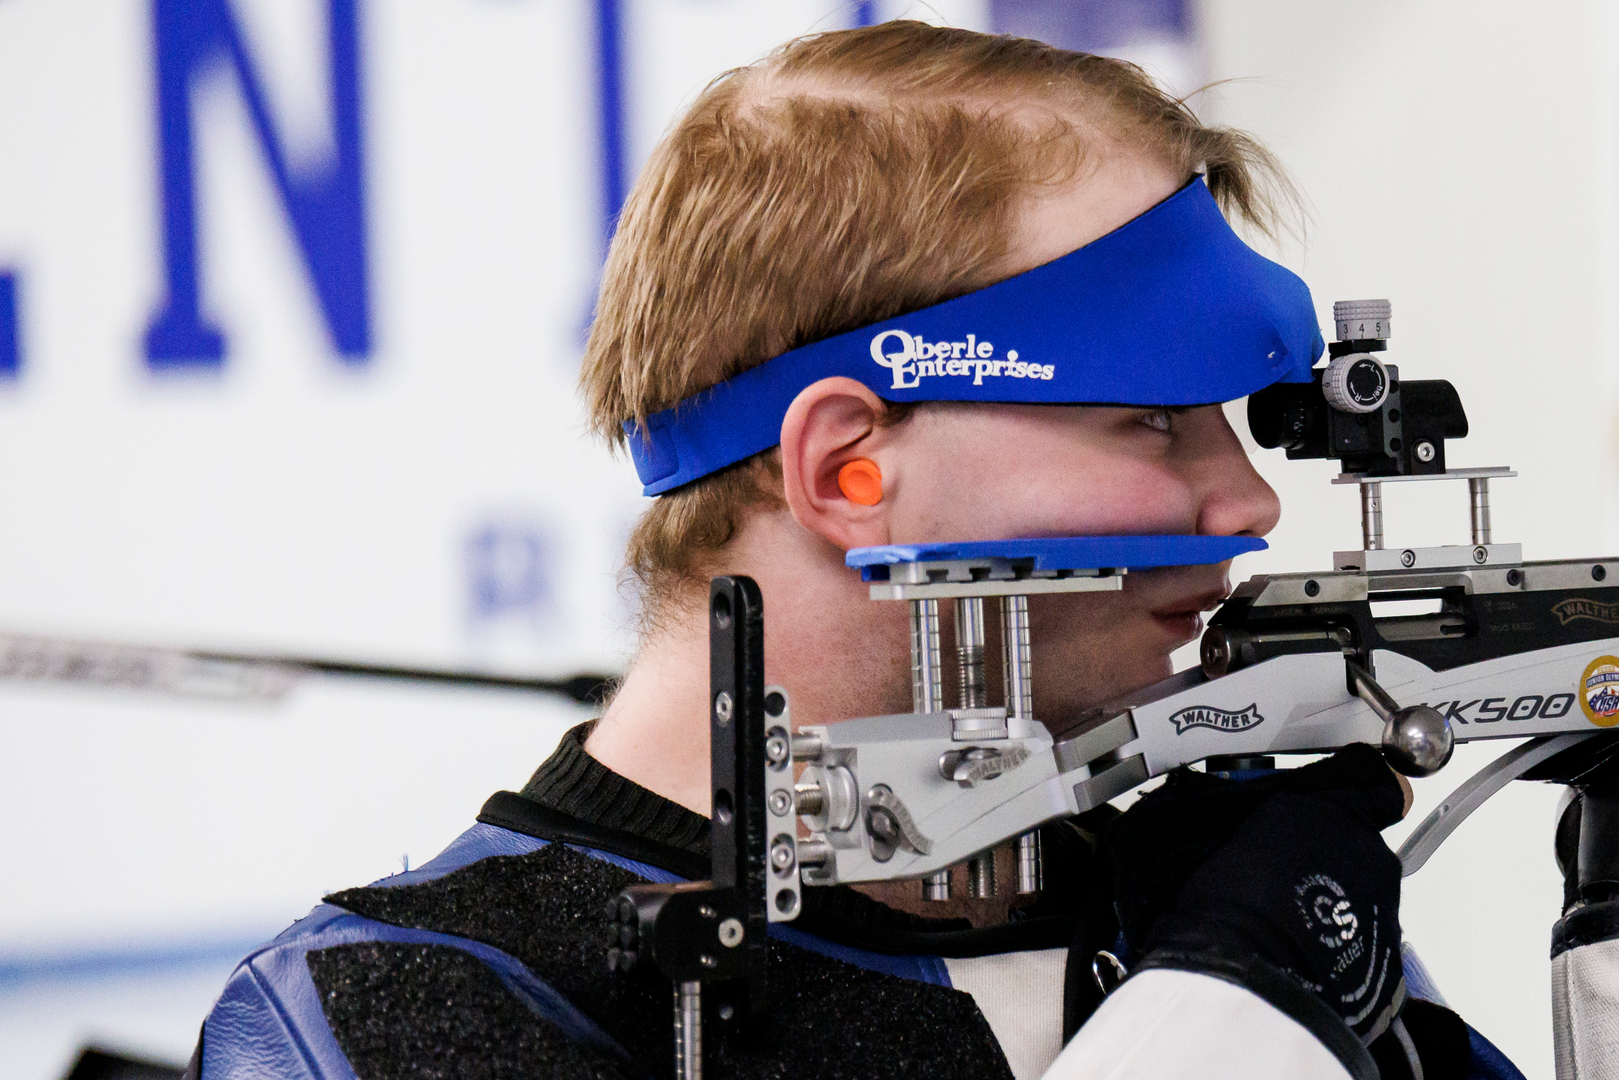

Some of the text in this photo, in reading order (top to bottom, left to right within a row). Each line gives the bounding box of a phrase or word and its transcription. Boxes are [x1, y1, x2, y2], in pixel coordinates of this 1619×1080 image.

[1343, 322, 1382, 334] 3 4 5
[870, 329, 994, 368] Oberle
[886, 350, 1055, 389] Enterprises
[1183, 710, 1251, 728] WALTHER
[1420, 693, 1576, 724] K500
